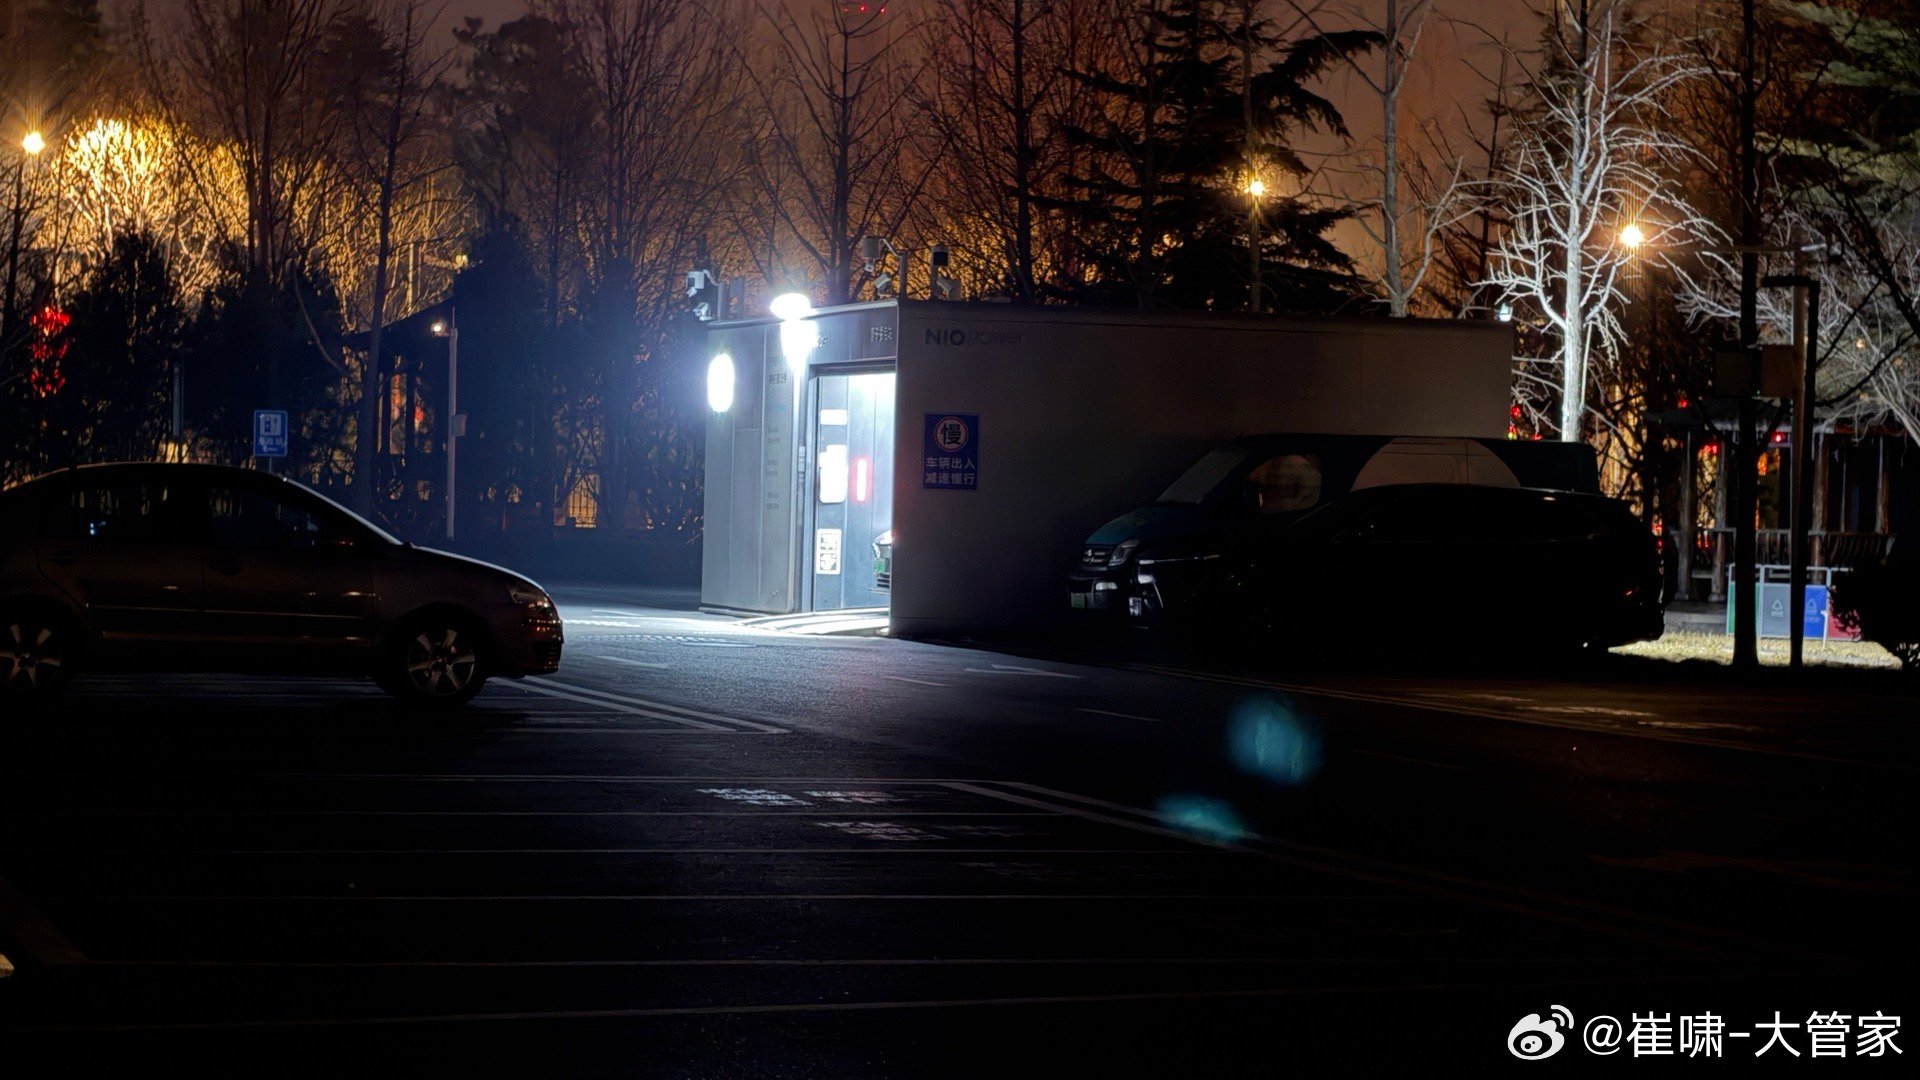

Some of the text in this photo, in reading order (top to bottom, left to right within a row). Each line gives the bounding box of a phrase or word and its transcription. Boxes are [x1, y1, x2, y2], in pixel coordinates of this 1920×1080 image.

[925, 328, 966, 346] NIO
[942, 423, 961, 445] 慢
[925, 456, 976, 470] 车辆出入
